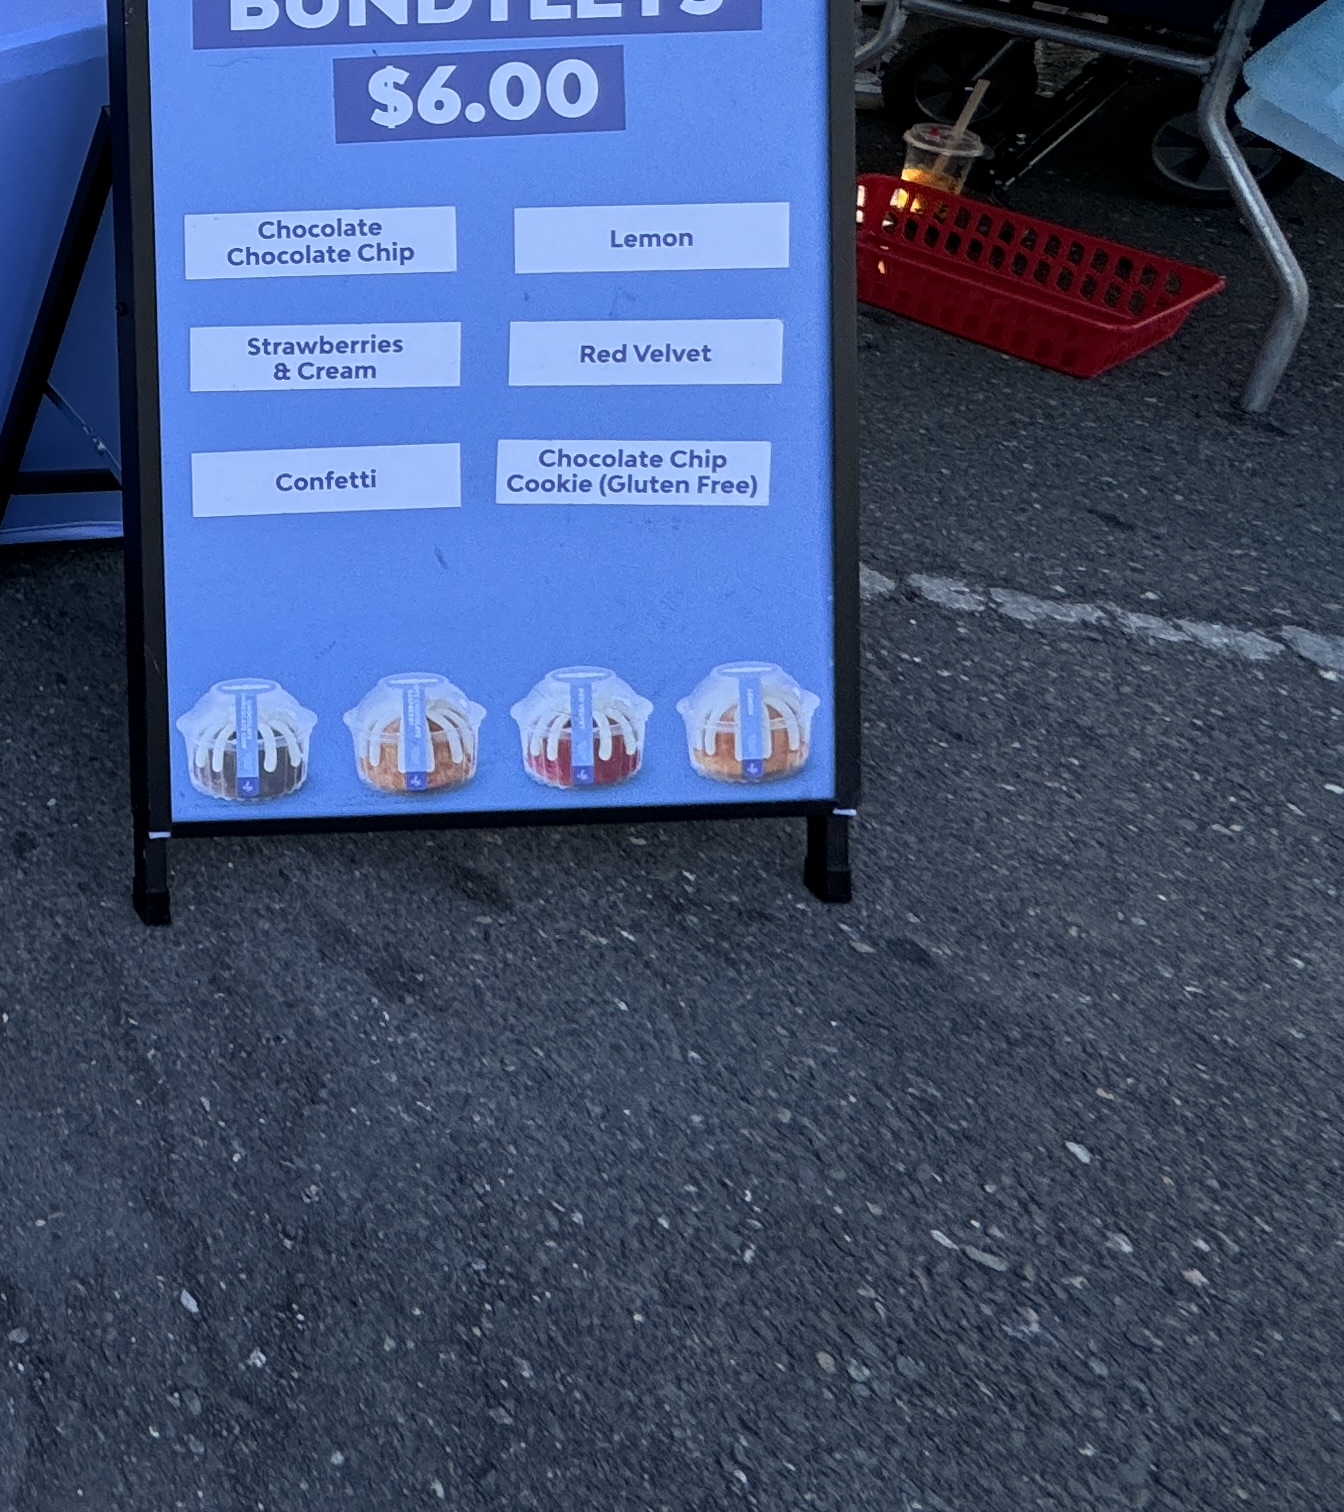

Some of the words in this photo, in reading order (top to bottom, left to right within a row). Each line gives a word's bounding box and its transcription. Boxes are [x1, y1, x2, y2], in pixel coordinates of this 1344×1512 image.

[368, 58, 600, 130] $6.00
[257, 217, 384, 241] Chocolate
[610, 227, 695, 250] Lemon
[226, 244, 352, 268] Chocolate
[357, 241, 416, 267] Chip
[247, 334, 405, 358] Strawberries
[579, 343, 628, 365] Red
[633, 342, 713, 365] Velvet
[273, 361, 292, 382] &
[297, 360, 378, 382] Cream
[538, 447, 664, 471] Chocolate
[669, 448, 728, 474] Chip
[275, 468, 377, 493] Confetti
[506, 473, 593, 495] Cookie
[599, 473, 690, 499] (Gluten
[696, 473, 760, 499] Free)
